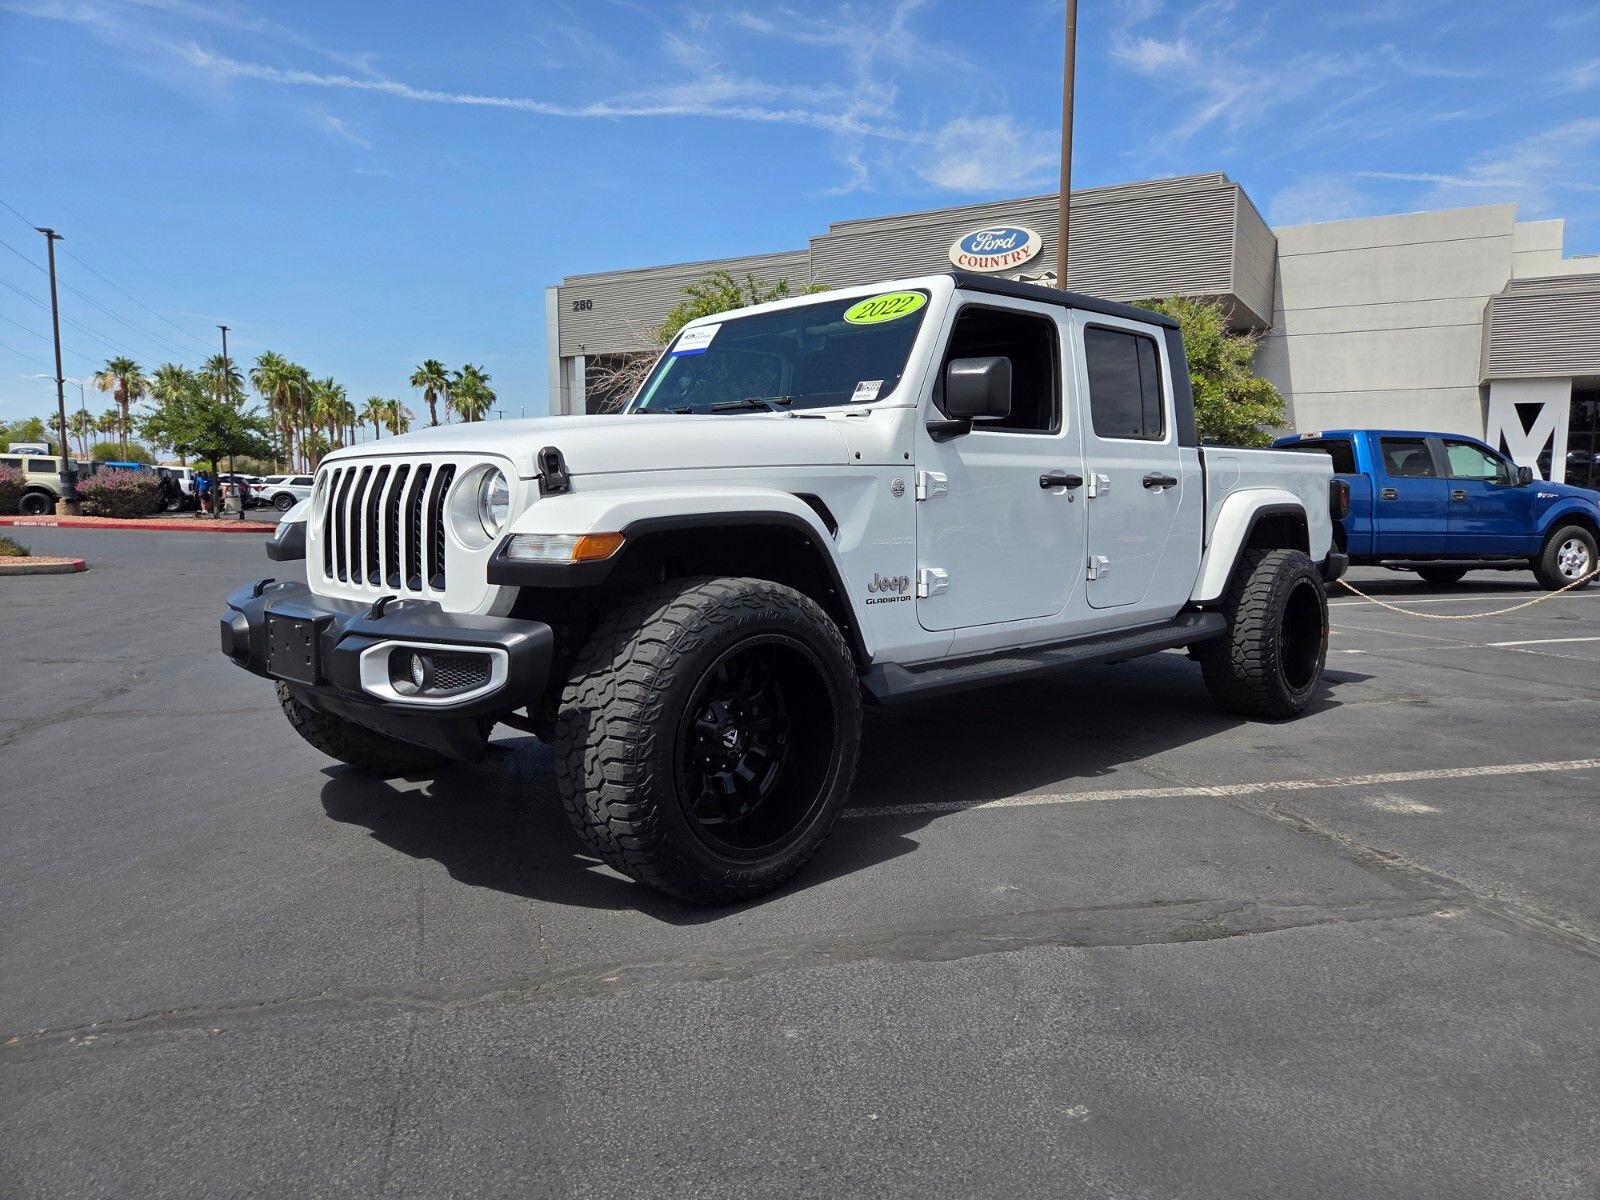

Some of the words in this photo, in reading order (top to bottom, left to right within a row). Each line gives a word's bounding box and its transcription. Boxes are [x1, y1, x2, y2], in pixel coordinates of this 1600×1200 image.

[971, 230, 1017, 252] Ford
[958, 246, 1031, 268] COUNTRY
[573, 299, 593, 312] 280
[854, 296, 915, 319] 2022
[868, 572, 910, 595] Jeep
[866, 595, 911, 605] GLADIATOR
